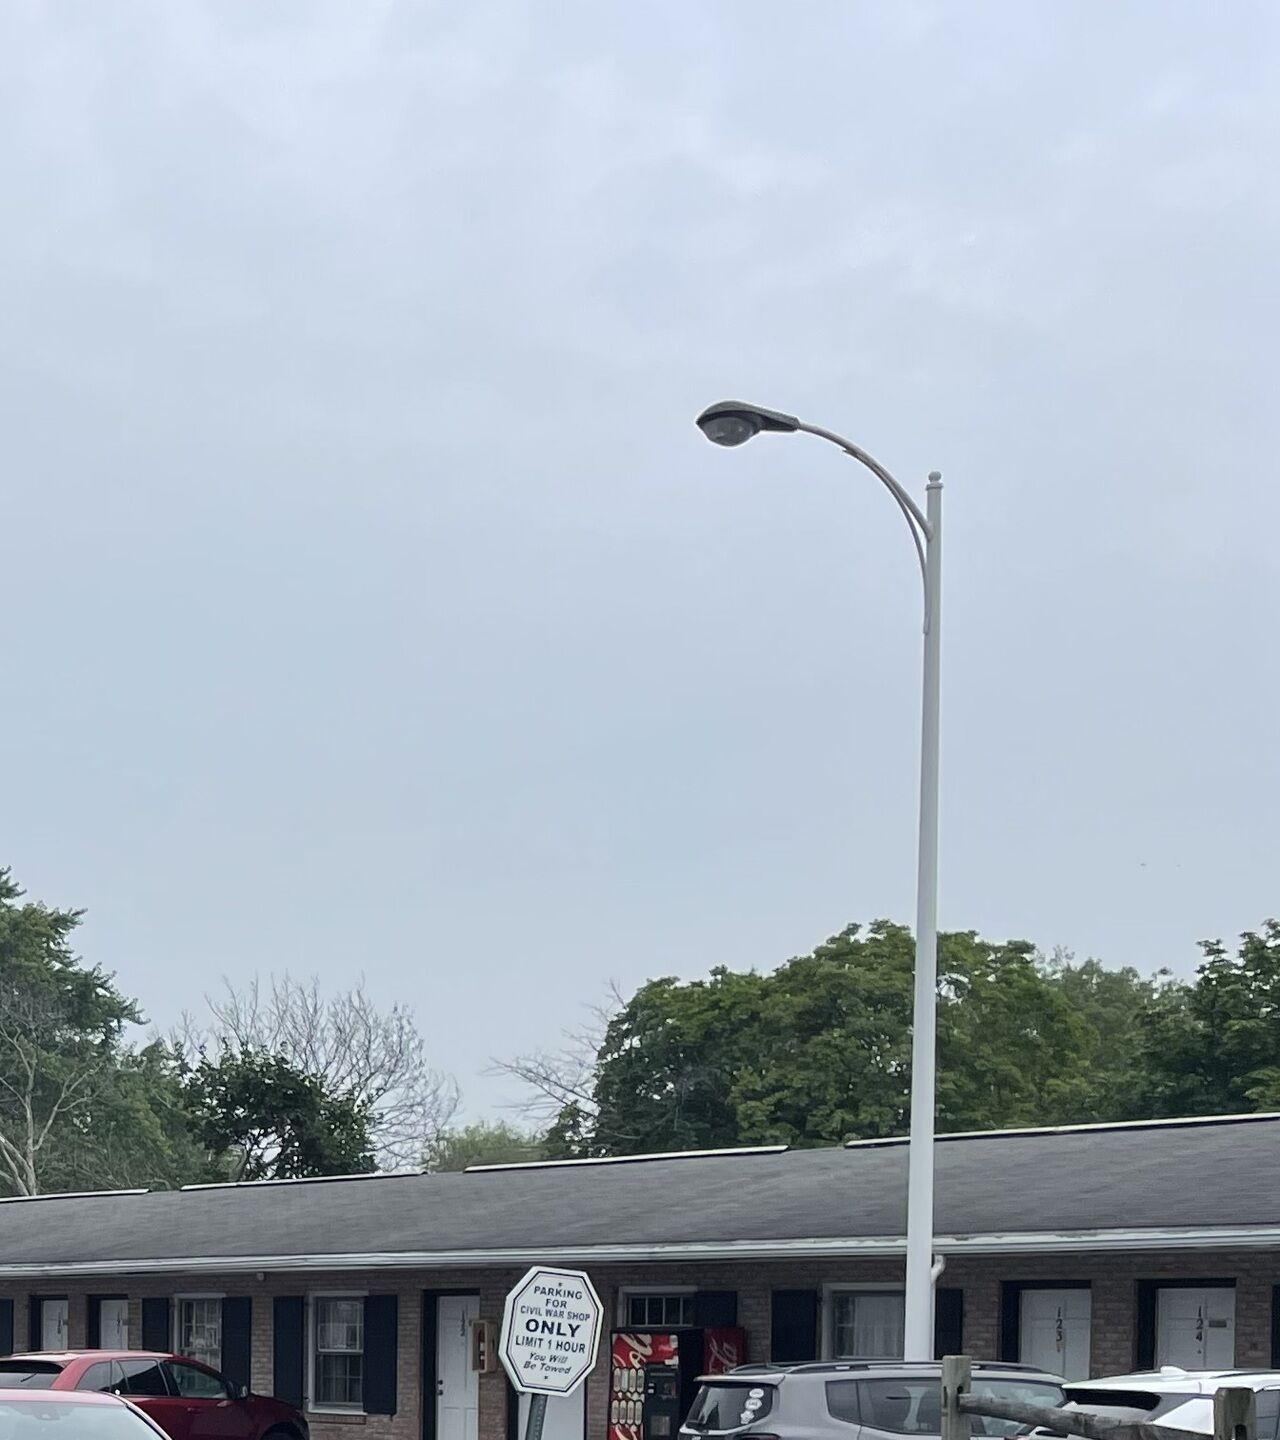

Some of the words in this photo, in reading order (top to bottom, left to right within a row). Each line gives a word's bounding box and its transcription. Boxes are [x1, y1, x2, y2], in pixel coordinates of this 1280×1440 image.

[533, 1286, 583, 1300] PARKING
[545, 1298, 567, 1309] FOR
[520, 1305, 542, 1317] CIVIL
[545, 1308, 565, 1319] WAR
[567, 1312, 590, 1321] SHOP
[525, 1318, 581, 1338] ONLY
[1195, 1306, 1203, 1342] 124
[515, 1335, 544, 1349] LIMIT
[547, 1339, 552, 1349] 1
[555, 1341, 586, 1354] HOUR
[529, 1352, 547, 1362] You
[549, 1354, 568, 1364] Will
[523, 1360, 536, 1370] Be
[540, 1363, 572, 1374] Towed
